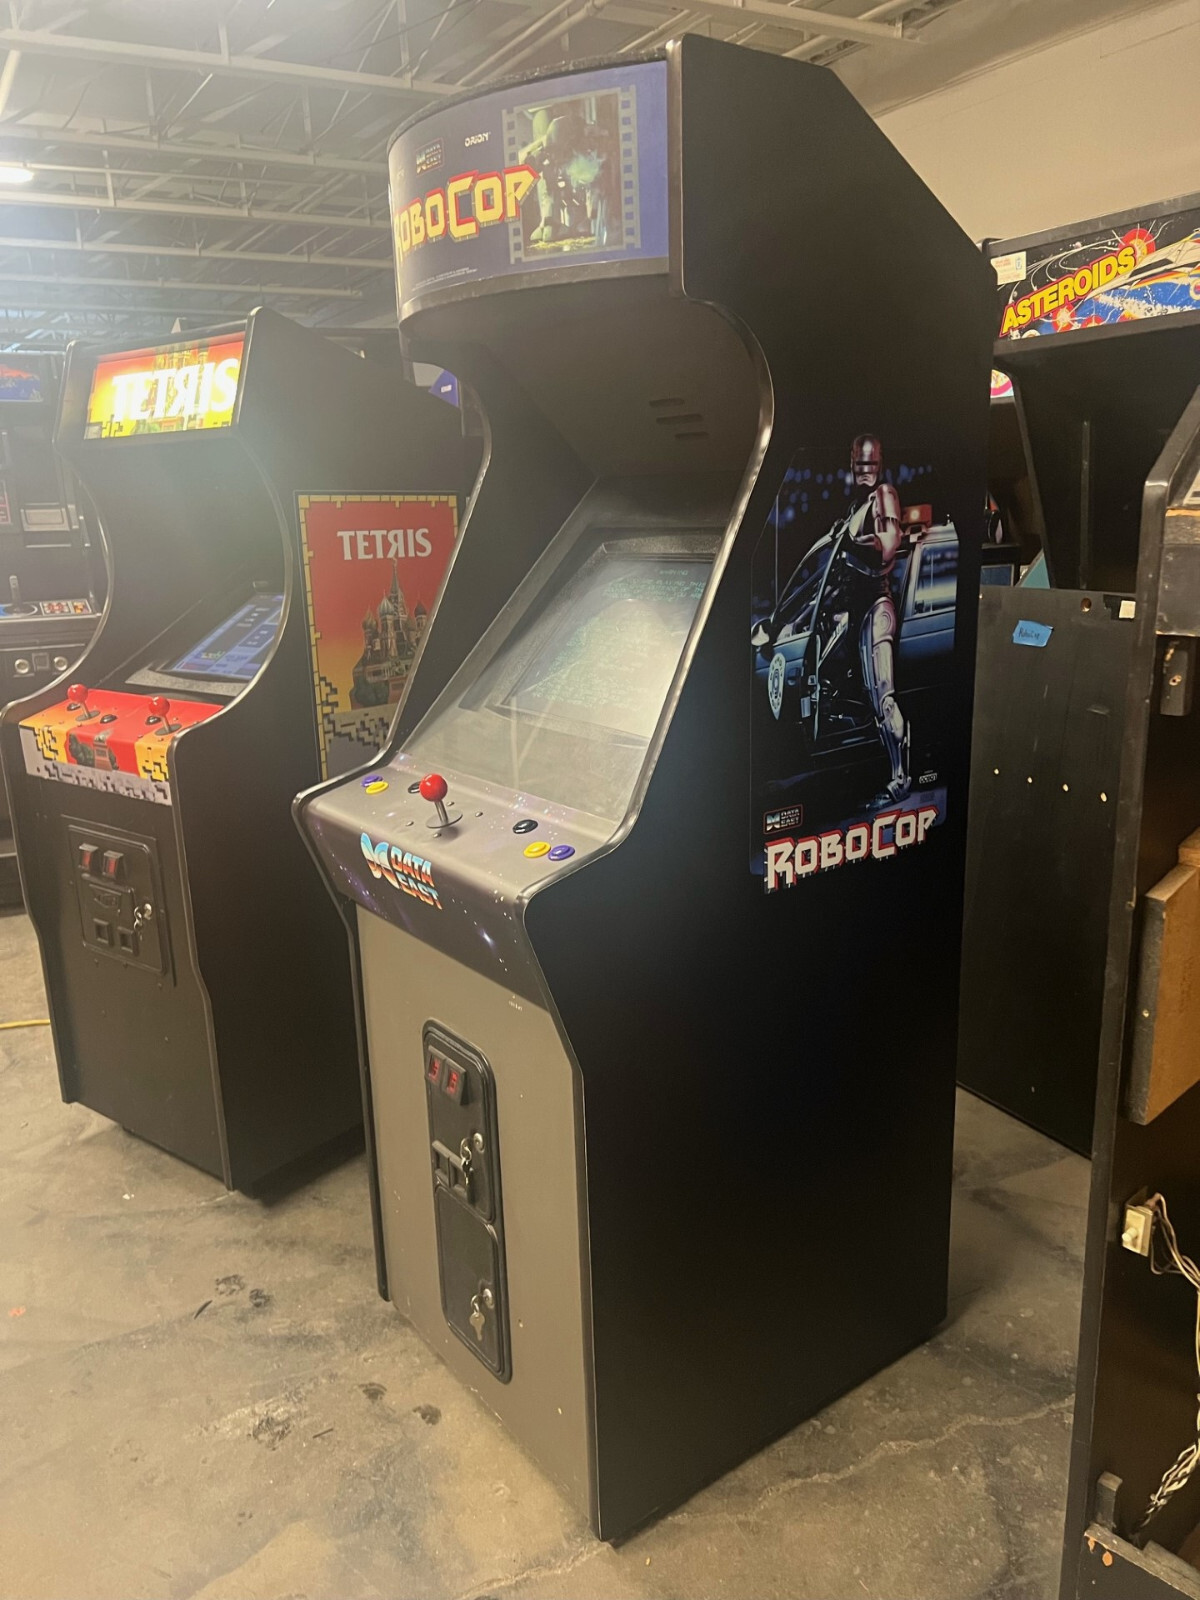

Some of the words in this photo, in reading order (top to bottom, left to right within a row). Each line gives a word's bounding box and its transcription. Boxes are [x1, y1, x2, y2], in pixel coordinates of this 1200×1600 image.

[464, 131, 490, 147] ORION
[1000, 246, 1137, 337] ASTEROIDS
[390, 846, 435, 887] DATA
[397, 872, 443, 910] EAST
